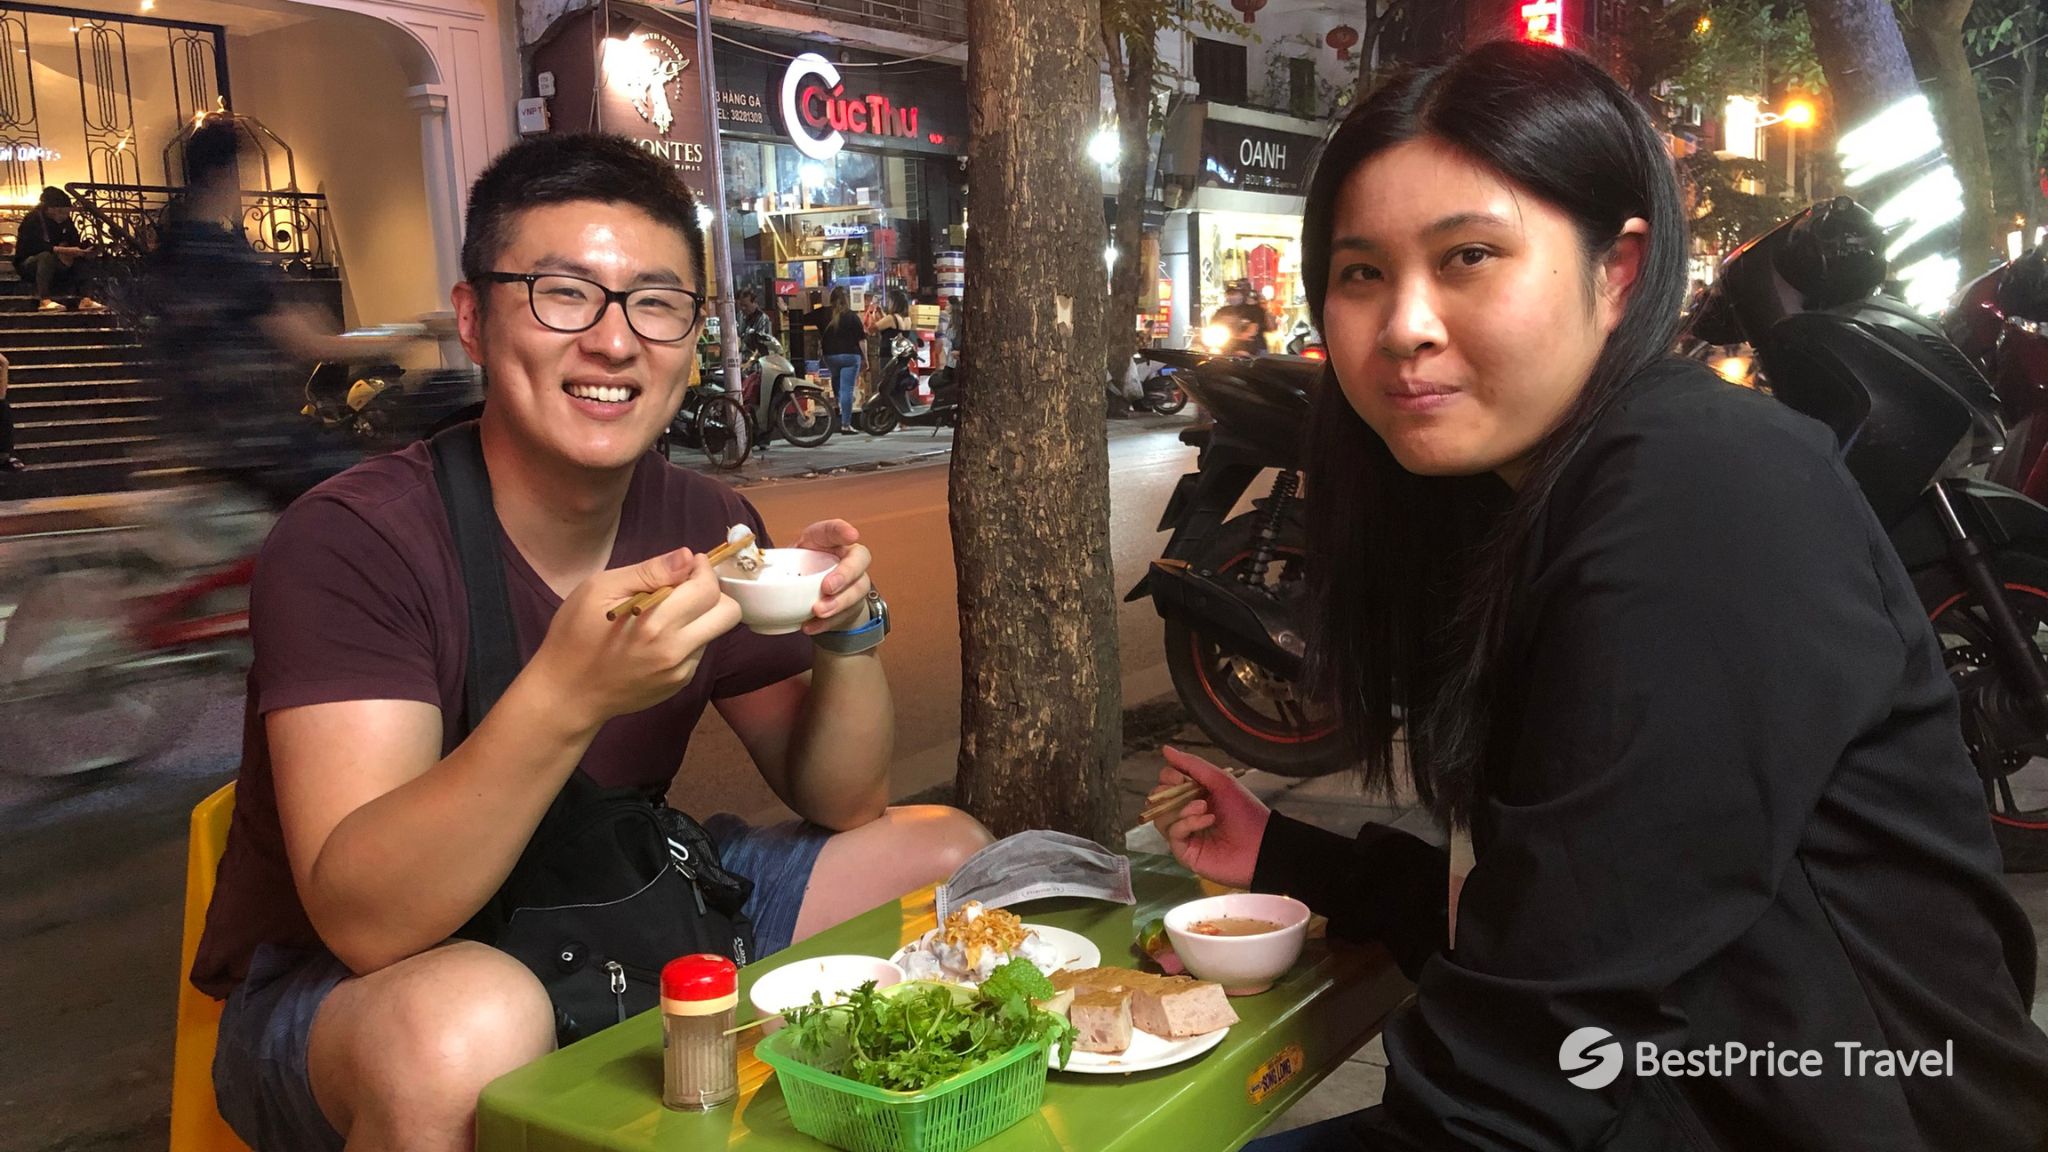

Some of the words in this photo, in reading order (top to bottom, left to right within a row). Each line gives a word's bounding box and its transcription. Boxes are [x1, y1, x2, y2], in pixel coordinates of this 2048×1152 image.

[722, 90, 747, 106] HÀNG
[748, 94, 762, 108] GÀ
[802, 84, 867, 134] Cúc
[522, 107, 543, 116] VNPT
[717, 108, 730, 120] EL:
[633, 138, 703, 163] ONTES
[1240, 138, 1287, 170] OANH
